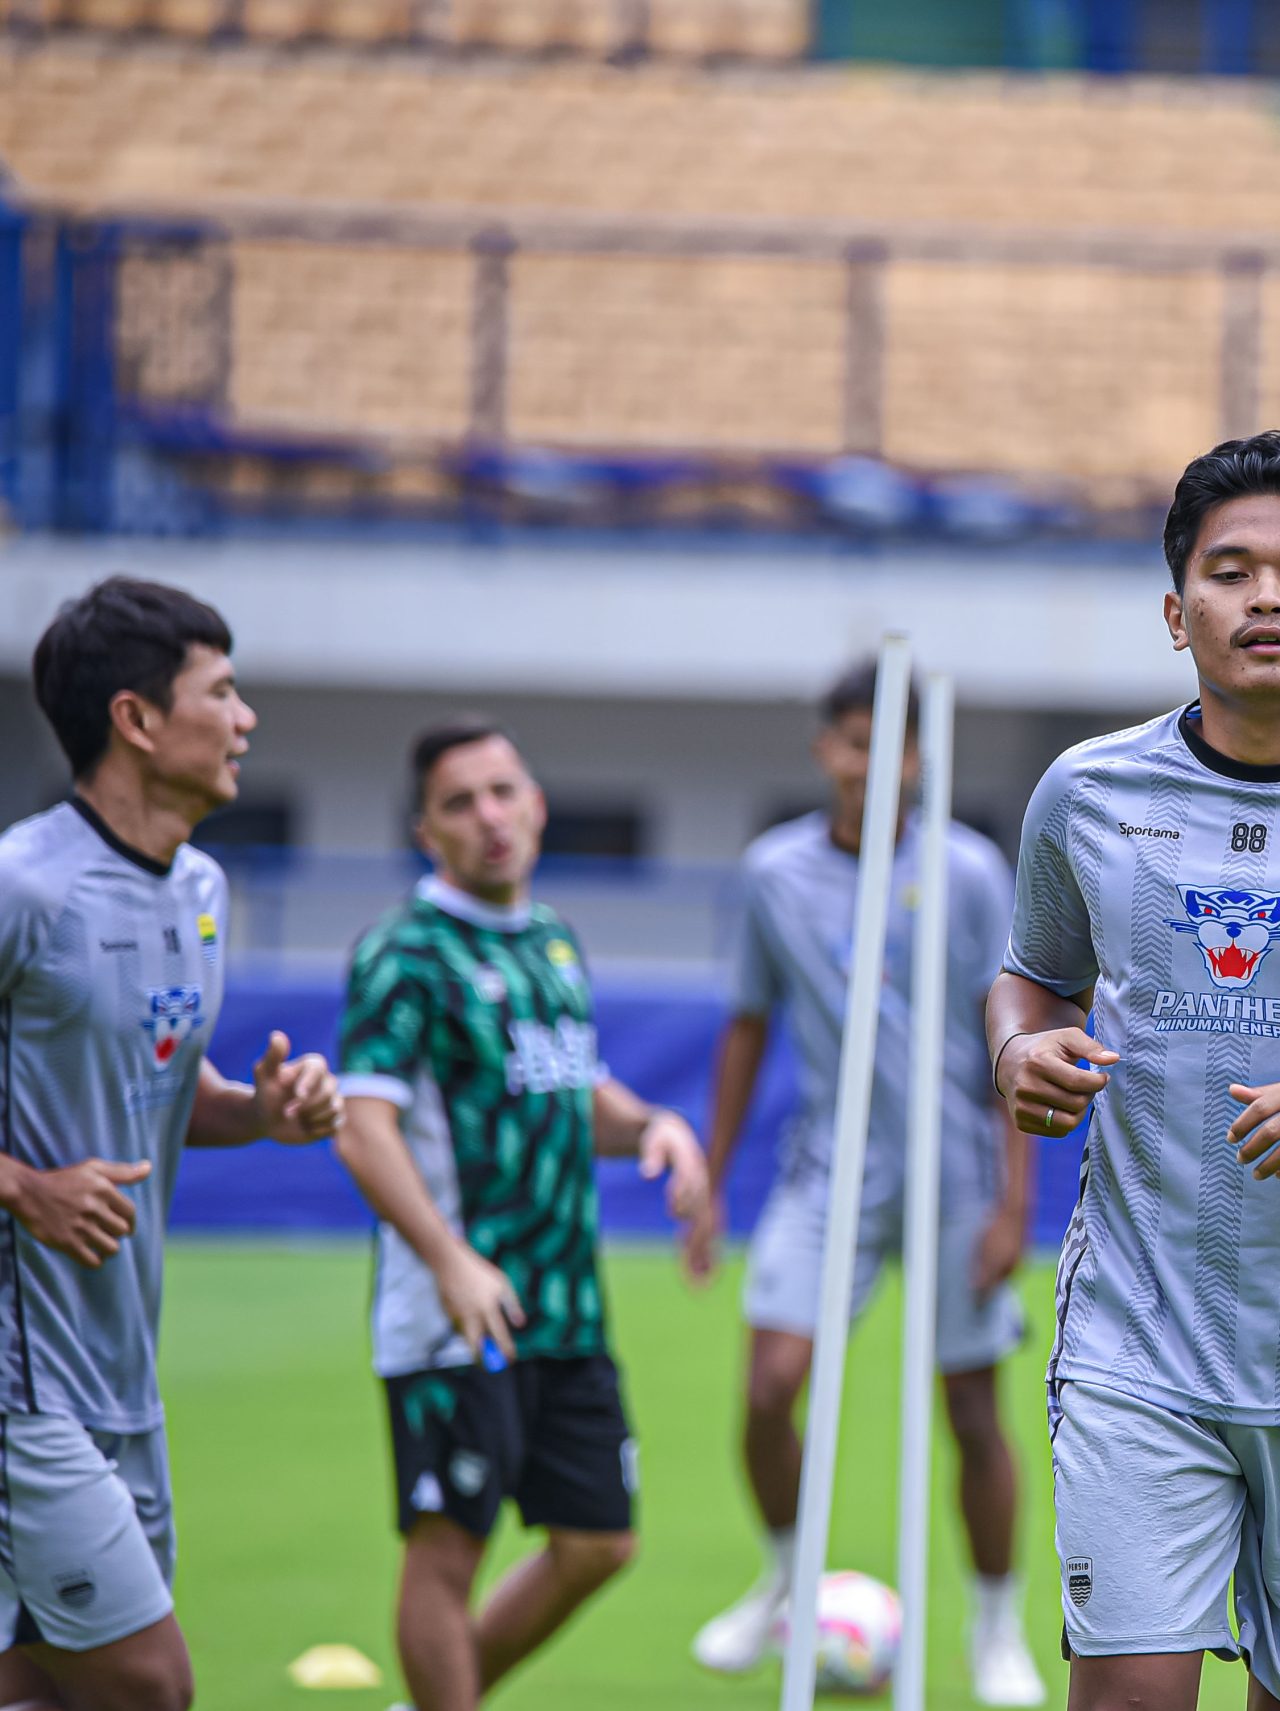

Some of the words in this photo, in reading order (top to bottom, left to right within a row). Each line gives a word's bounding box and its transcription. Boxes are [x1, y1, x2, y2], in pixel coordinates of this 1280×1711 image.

[1118, 822, 1180, 840] Sportama
[1230, 822, 1268, 853] 88
[1154, 1017, 1236, 1034] MINUMAN
[1068, 1562, 1089, 1572] PERSIB
